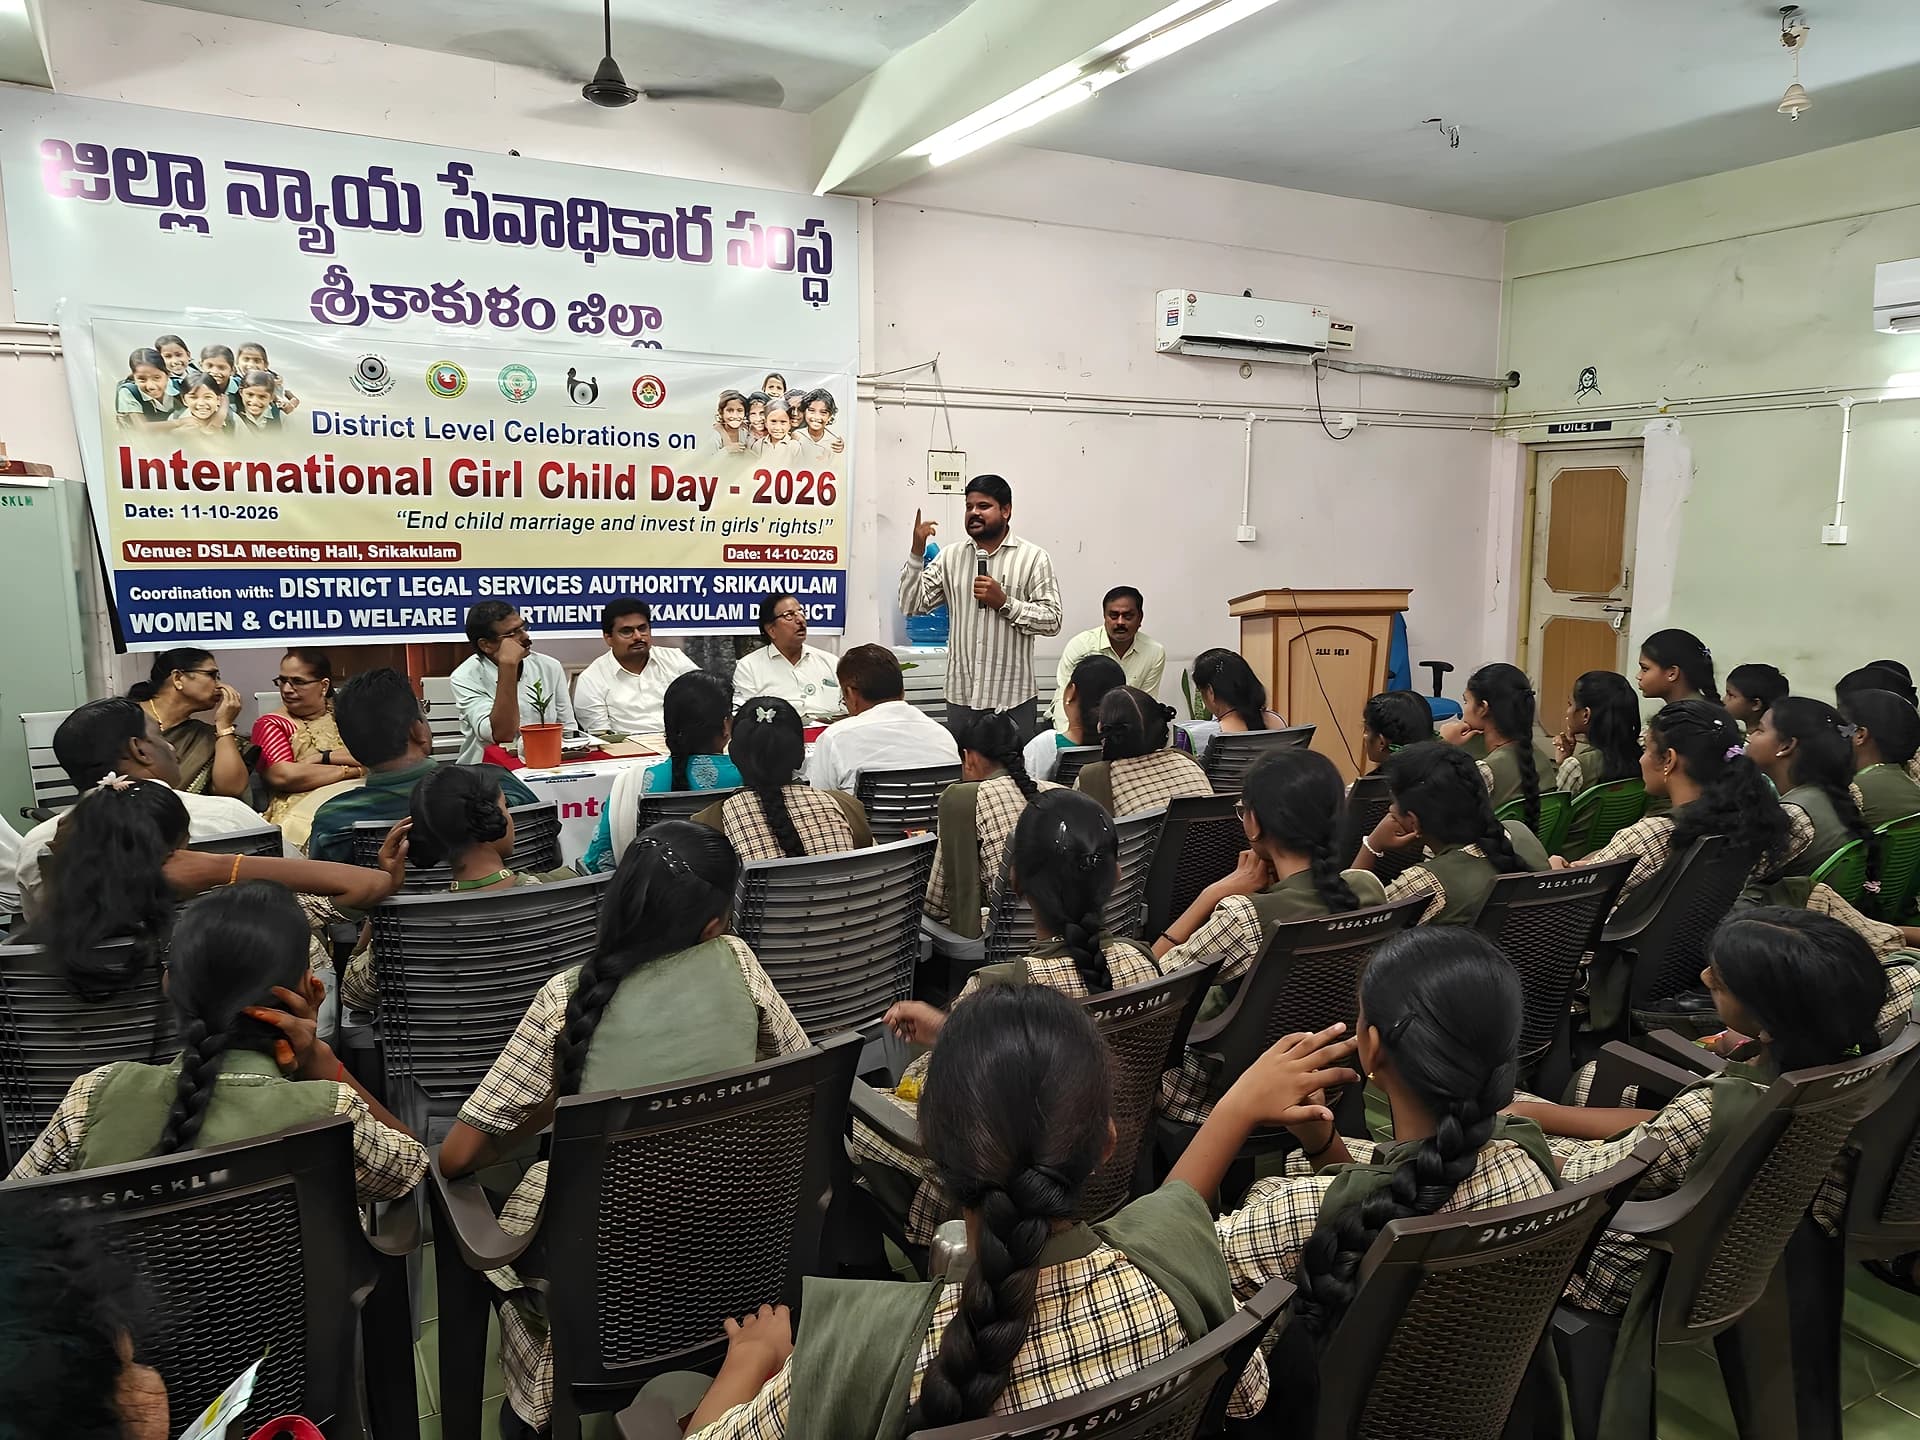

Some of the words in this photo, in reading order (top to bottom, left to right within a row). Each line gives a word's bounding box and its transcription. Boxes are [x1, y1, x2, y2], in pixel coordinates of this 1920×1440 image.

[40, 138, 210, 234] జిల్లా
[224, 160, 421, 254] న్యాయ
[436, 161, 713, 264] సేవాధికార
[310, 264, 556, 331] శ్రీకాకుళం
[311, 410, 416, 439] District
[424, 416, 495, 441] Level
[504, 420, 660, 449] Celebrations
[668, 431, 696, 449] on
[119, 446, 433, 496] International
[449, 457, 522, 499] Girl
[537, 461, 636, 501] Child
[651, 465, 719, 511] Day
[729, 484, 740, 495] -
[752, 468, 837, 507] 2026
[124, 503, 175, 518] Date:
[180, 504, 279, 520] 11-10-2026
[454, 511, 504, 530] child
[510, 514, 595, 535] marriage
[600, 514, 635, 531] and
[640, 515, 695, 532] invest
[700, 516, 716, 532] in
[126, 543, 192, 559] Venue:
[197, 543, 247, 558] DSLA
[251, 545, 321, 562] Meeting
[325, 545, 363, 562] Hall,
[367, 545, 457, 560] Srikakulam
[727, 547, 761, 560] Date:
[764, 548, 834, 561] 14-10-2026
[129, 586, 231, 601] Coordination
[235, 586, 275, 600] with:
[278, 576, 392, 599] DISTRICT
[398, 575, 473, 597] LEGAL
[478, 574, 583, 596] SERVICES
[588, 574, 708, 598] AUTHORITY,
[712, 575, 837, 595] SRIKAKULAM
[129, 611, 233, 634] WOMEN
[242, 610, 261, 631] &
[268, 609, 343, 631] CHILD
[348, 607, 457, 629] WELFARE
[649, 602, 744, 621] KAKULAM
